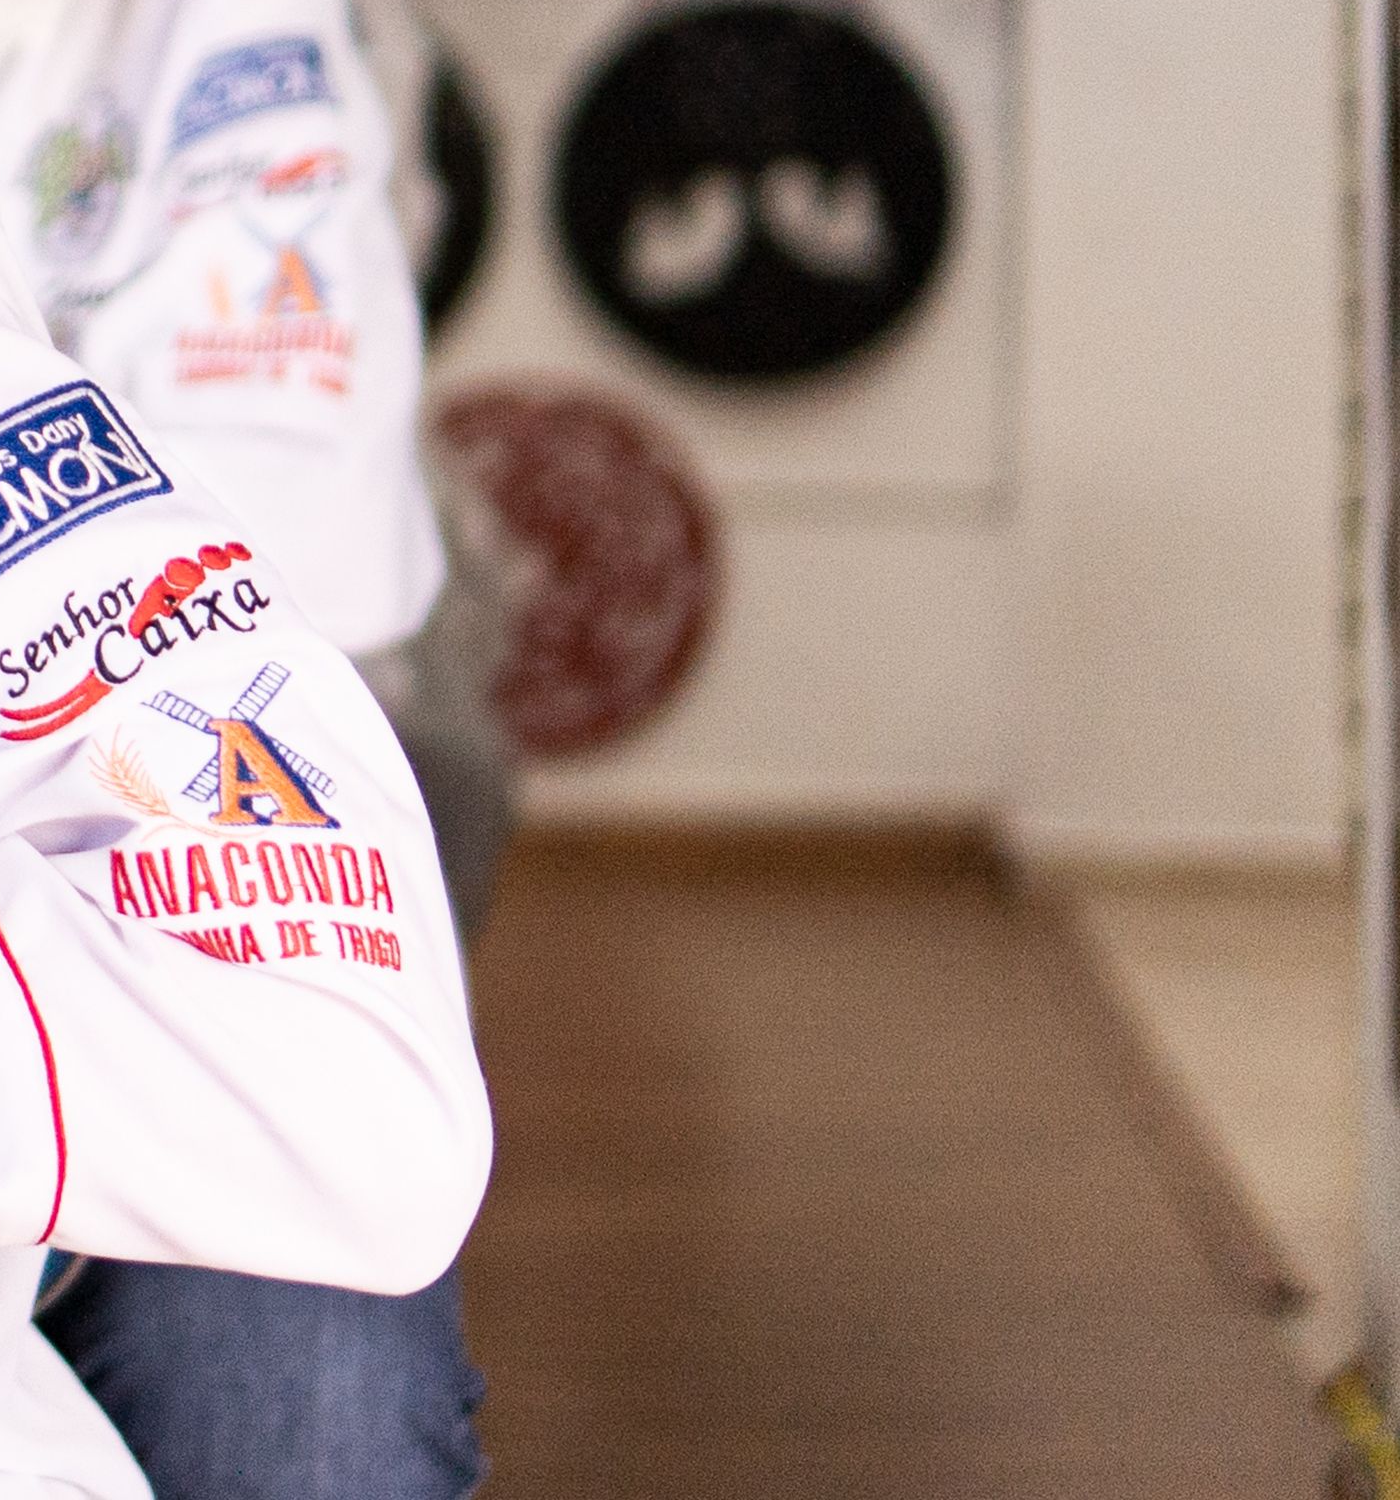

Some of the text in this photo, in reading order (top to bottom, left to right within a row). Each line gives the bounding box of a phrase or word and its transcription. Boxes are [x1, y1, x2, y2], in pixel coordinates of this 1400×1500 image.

[19, 412, 92, 455] Dany
[95, 577, 271, 685] Caixa
[208, 719, 340, 830] A
[110, 841, 394, 918] ANACONDA
[275, 920, 322, 959] DE
[330, 921, 401, 972] TRIGO
